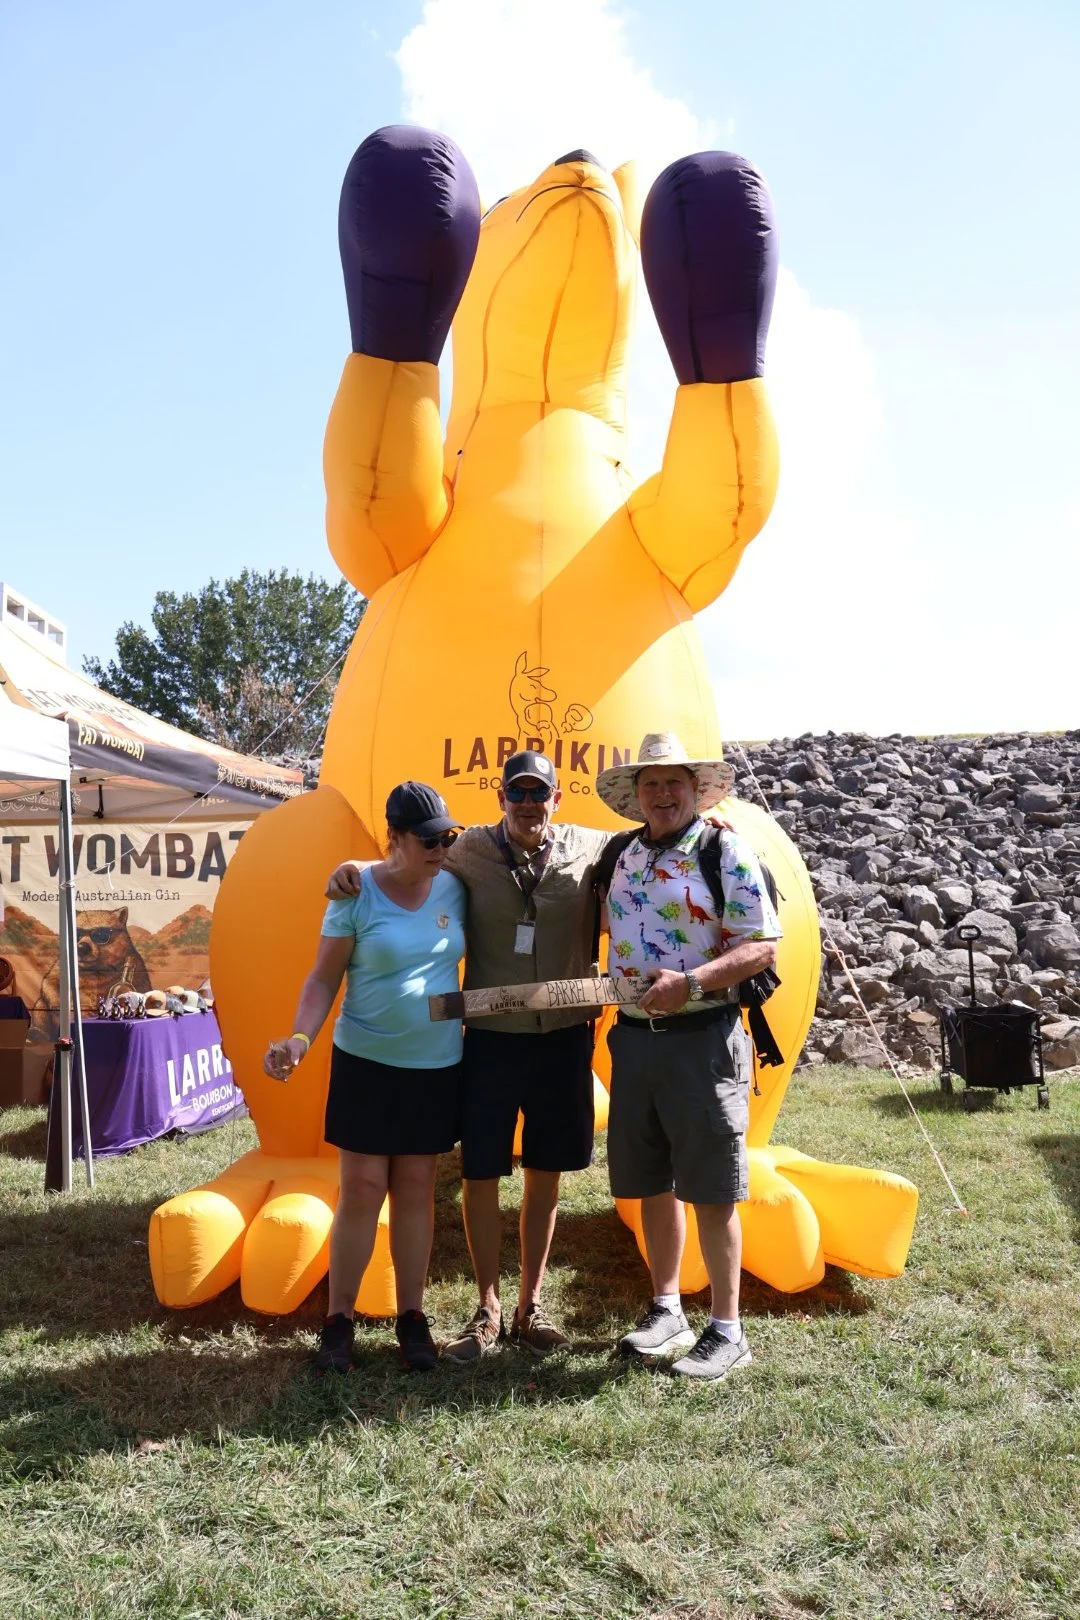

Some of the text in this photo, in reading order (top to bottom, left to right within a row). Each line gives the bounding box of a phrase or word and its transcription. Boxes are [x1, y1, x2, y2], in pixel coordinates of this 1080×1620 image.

[77, 722, 145, 761] FAT WOMBAT
[570, 782, 594, 796] Co.
[22, 889, 180, 902] Moder Australian Gin
[546, 980, 590, 1007] BARREL
[592, 978, 625, 1003] PICK
